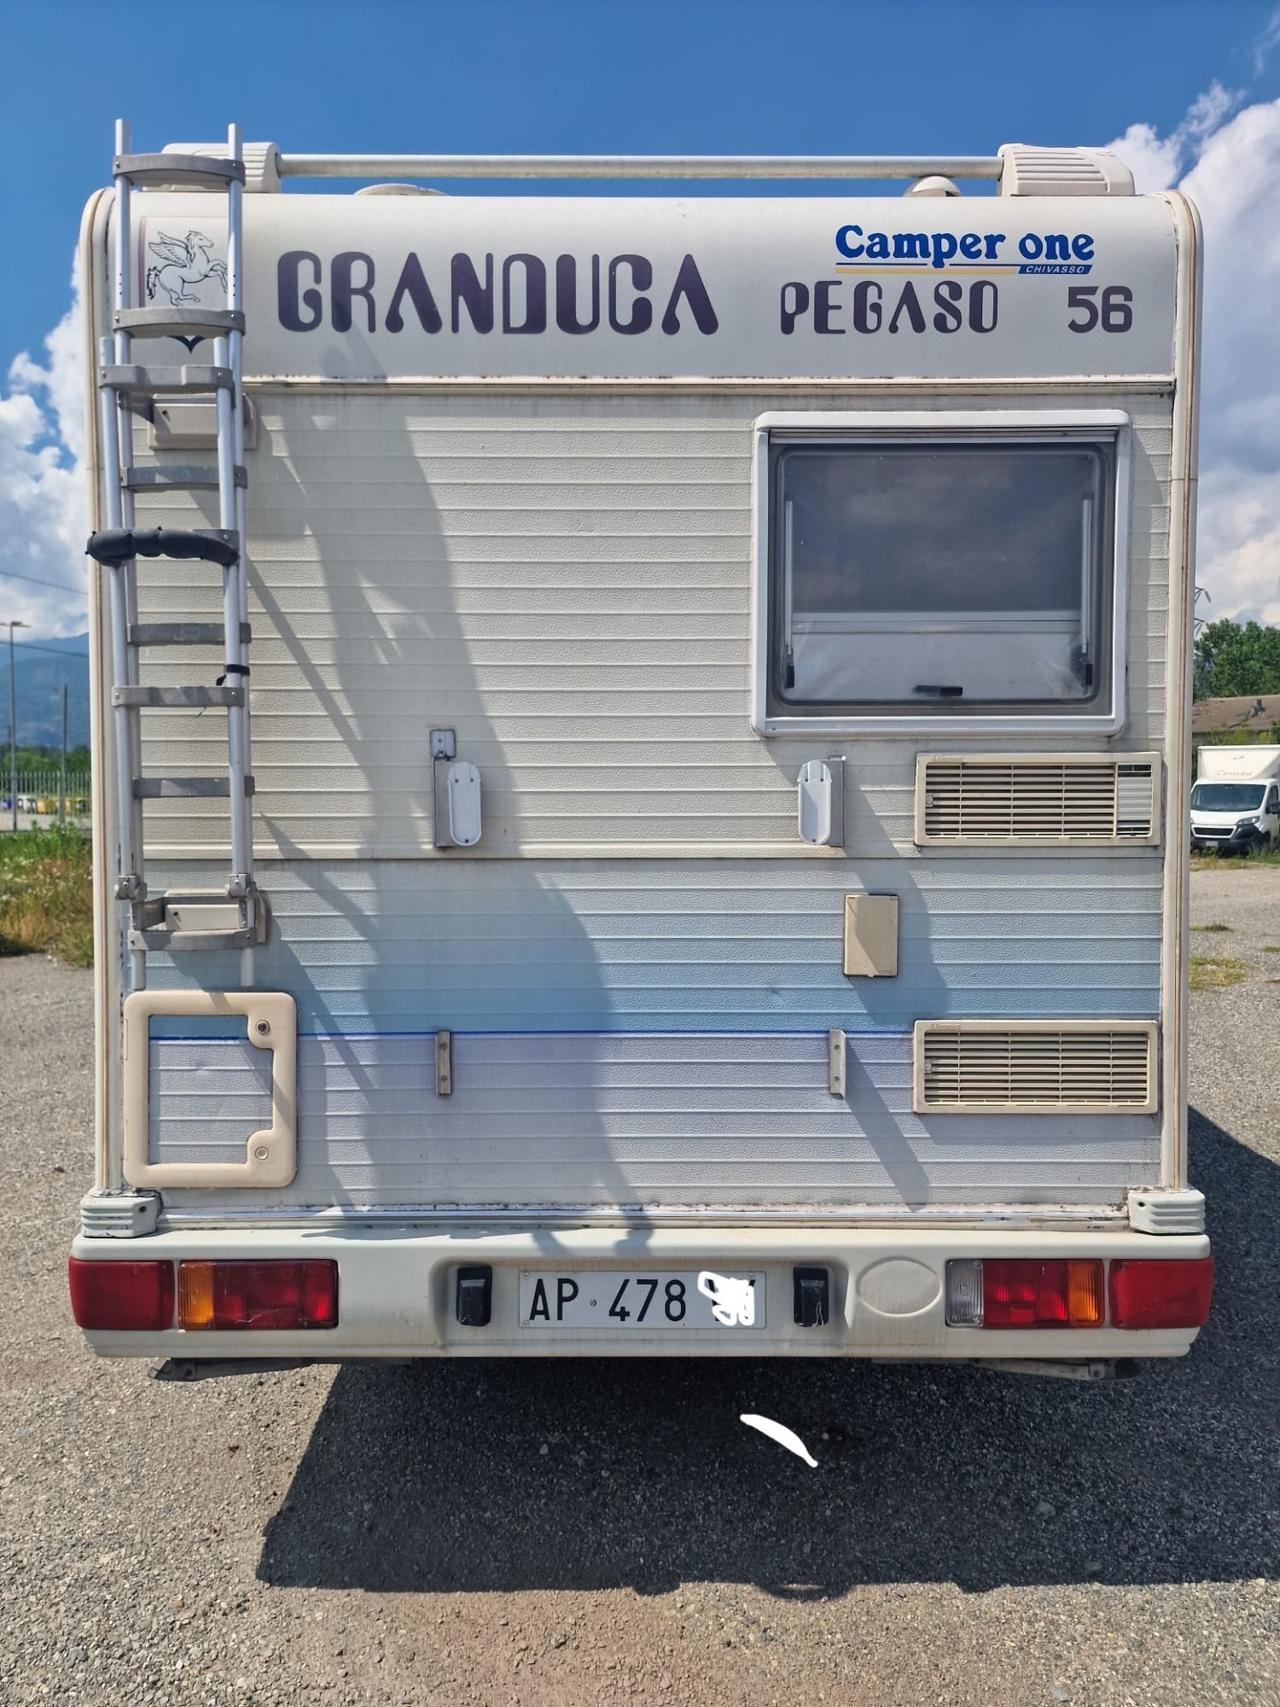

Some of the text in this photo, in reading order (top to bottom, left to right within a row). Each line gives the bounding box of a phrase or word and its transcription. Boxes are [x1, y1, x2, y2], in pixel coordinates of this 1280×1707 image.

[836, 225, 1096, 269] Camper one
[1025, 265, 1086, 274] CHIVASSO
[277, 250, 1133, 336] GRANDUCA PEGASO 56
[529, 1278, 579, 1321] AP
[608, 1278, 687, 1322] 478
